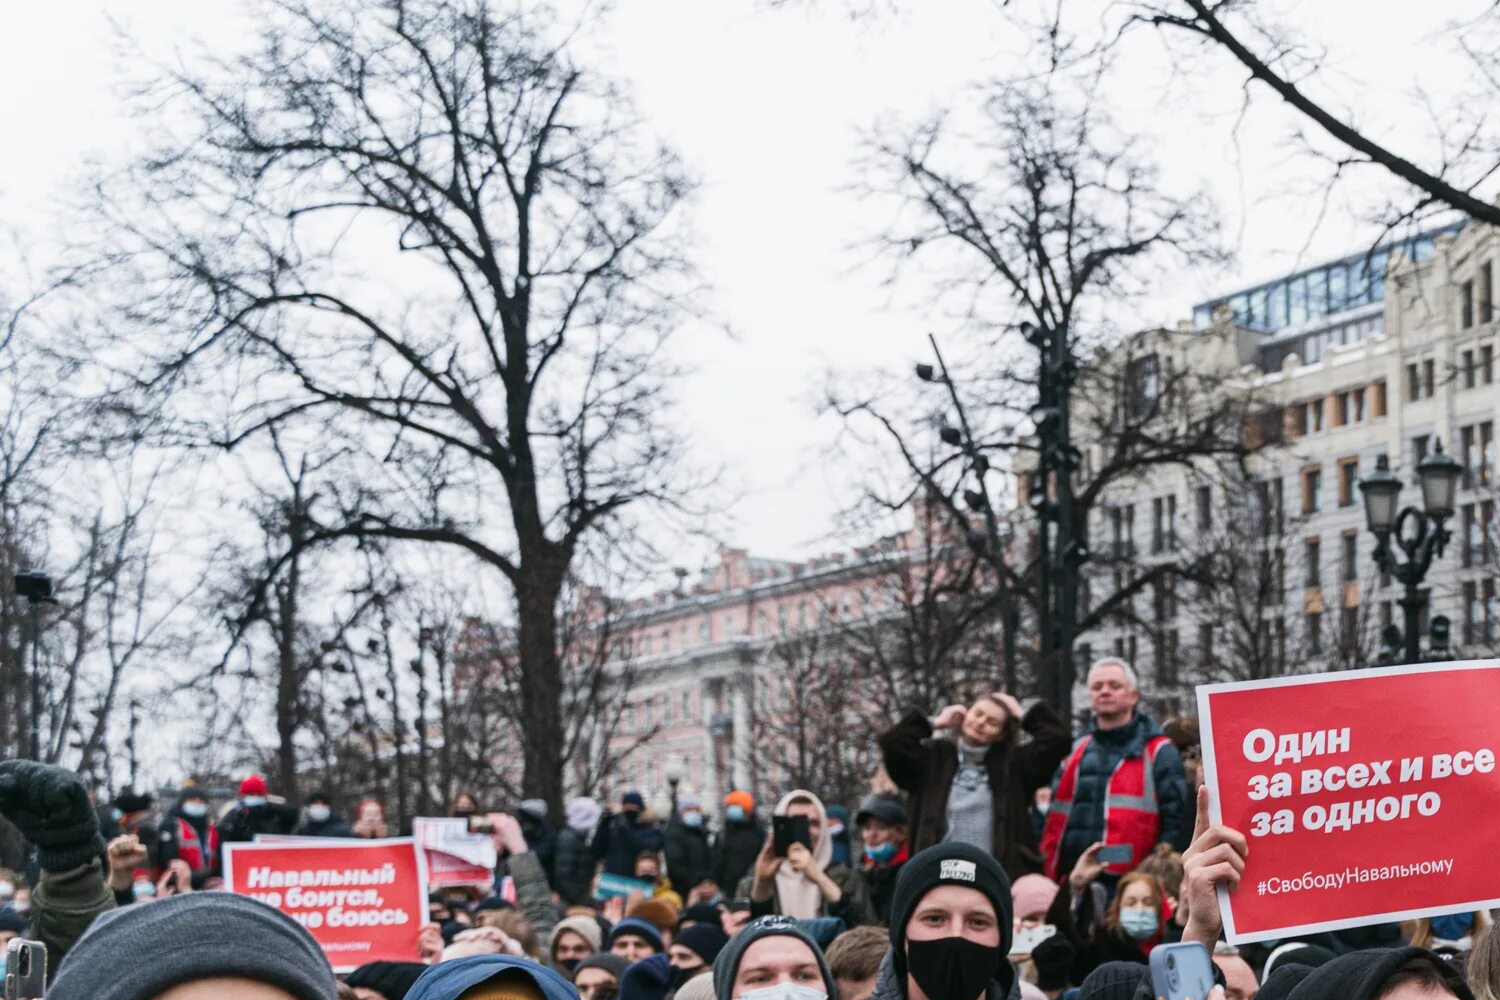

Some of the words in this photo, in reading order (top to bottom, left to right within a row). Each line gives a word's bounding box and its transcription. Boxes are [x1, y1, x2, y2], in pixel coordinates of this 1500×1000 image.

[1242, 727, 1351, 766] Один
[1247, 771, 1293, 801] за
[1300, 759, 1393, 795] всех
[1399, 755, 1424, 783] и
[1431, 748, 1496, 779] все
[1250, 808, 1295, 837] за
[1302, 791, 1441, 834] одного
[247, 862, 396, 888] Навальный
[1257, 857, 1454, 896] #СвободуНавальному
[285, 886, 384, 908] боится,
[326, 905, 409, 928] боюсь
